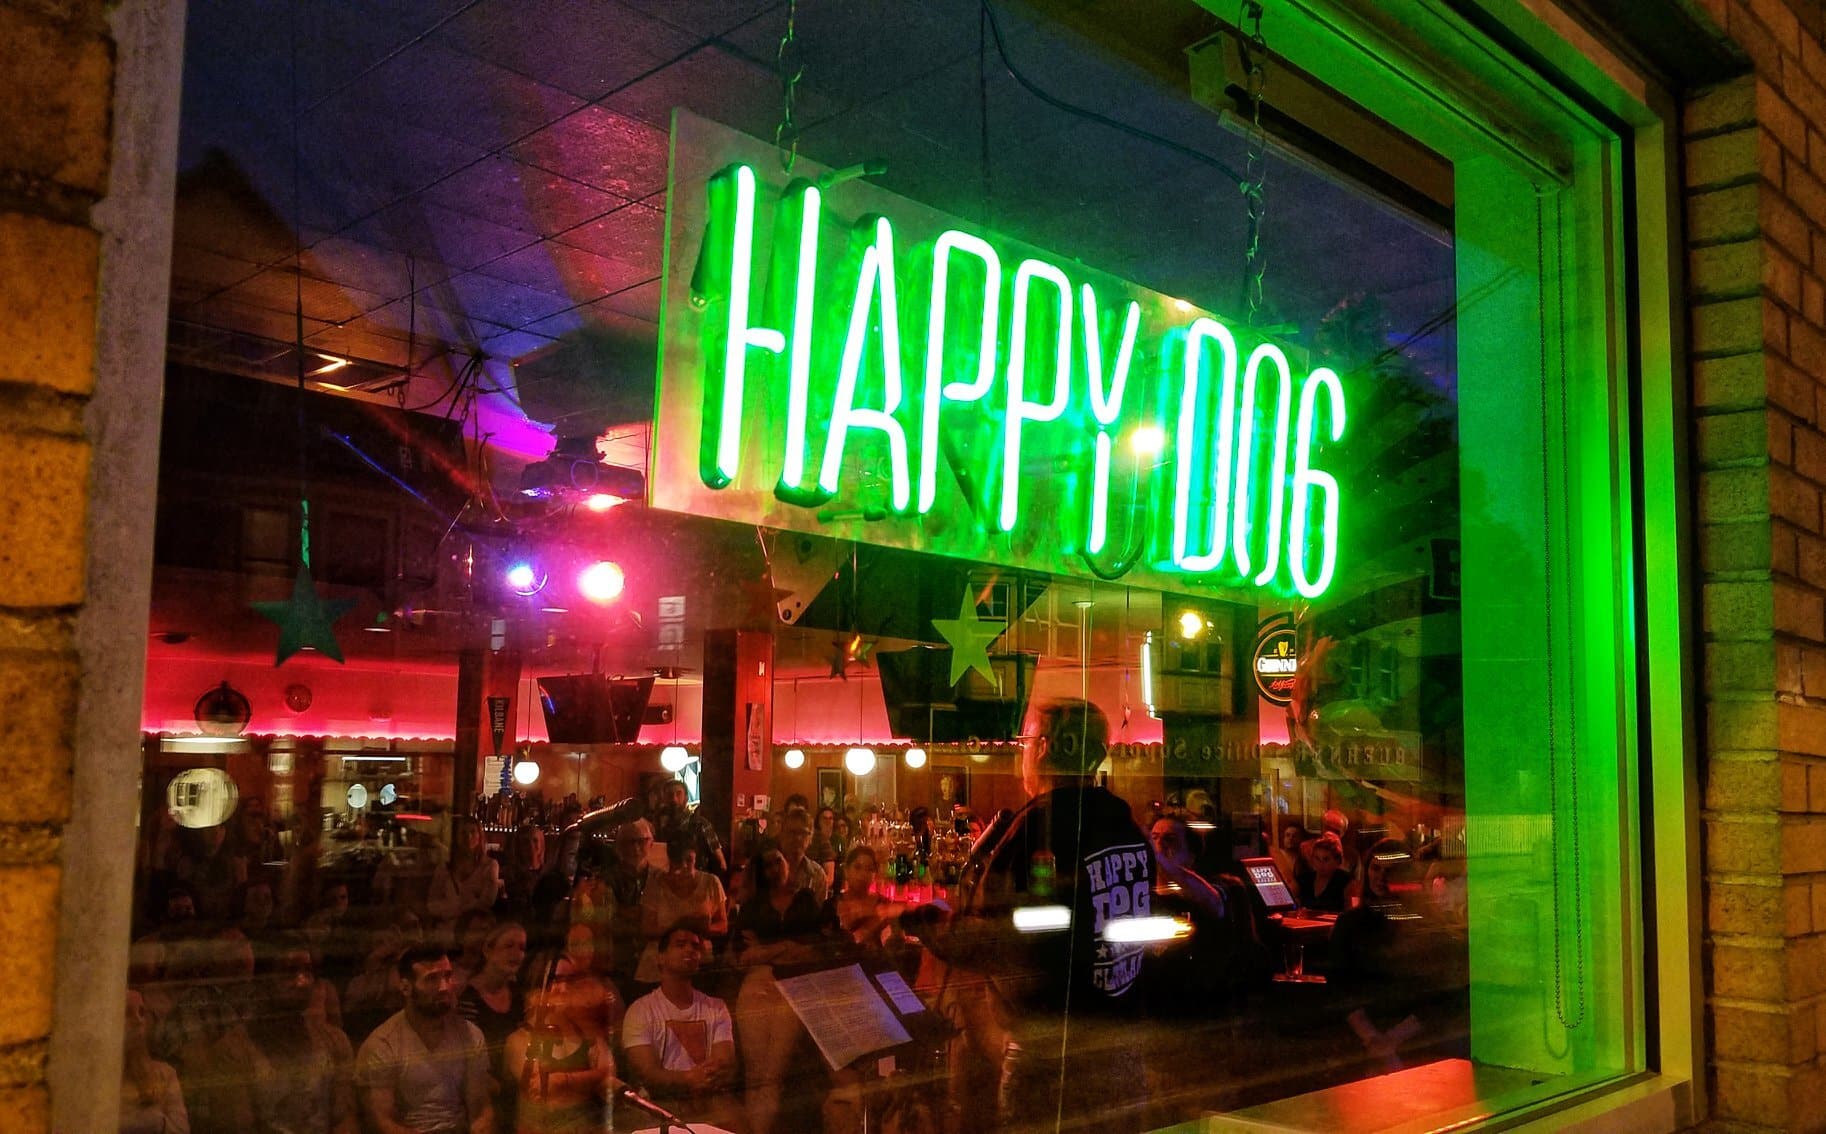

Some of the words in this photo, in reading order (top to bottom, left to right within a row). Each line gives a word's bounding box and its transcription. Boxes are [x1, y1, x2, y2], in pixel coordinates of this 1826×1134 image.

[711, 164, 1140, 555] HAPPY
[1173, 316, 1348, 599] DOG
[1086, 850, 1149, 893] HAPPY
